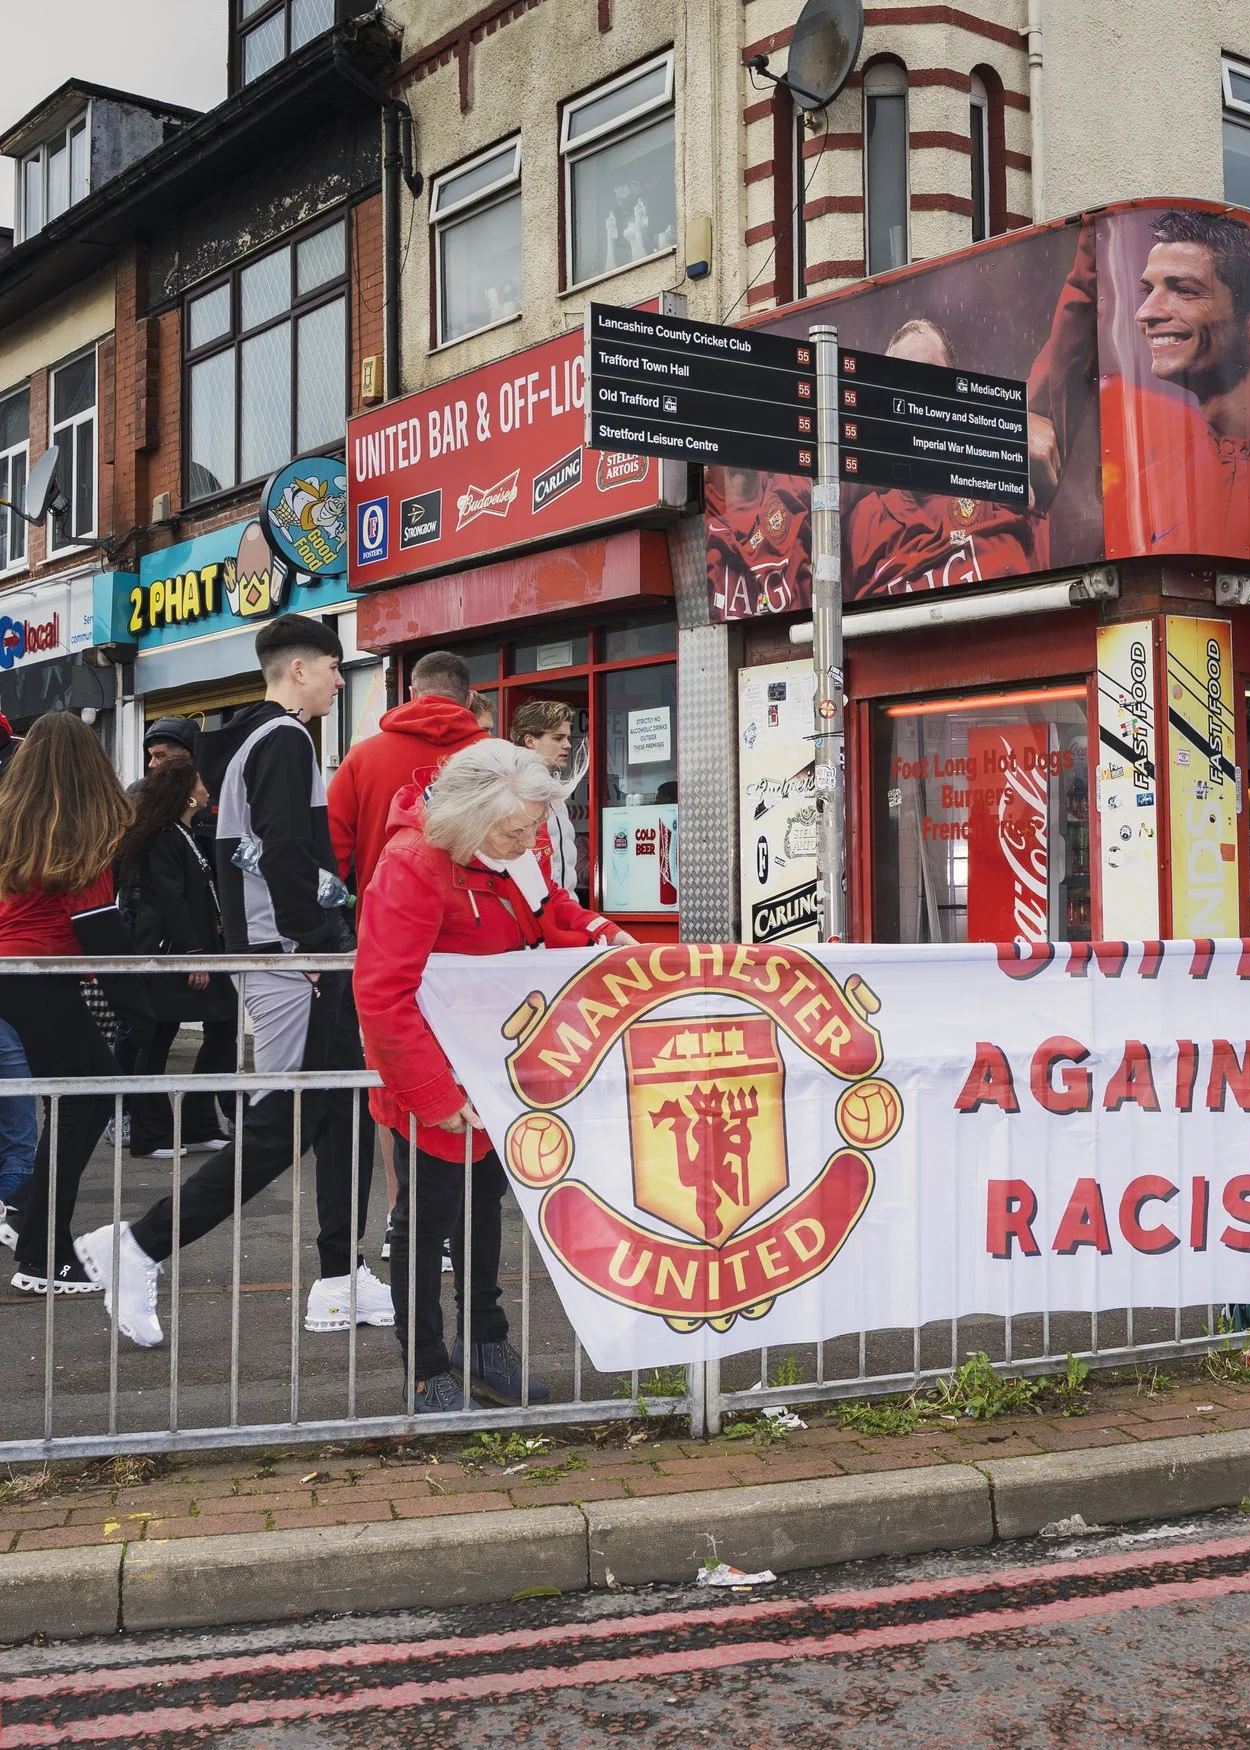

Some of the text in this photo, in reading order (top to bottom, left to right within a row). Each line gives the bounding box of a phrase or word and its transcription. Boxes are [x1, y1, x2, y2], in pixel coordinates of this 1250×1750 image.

[599, 315, 810, 362] Lancashire County Cricket Club 55
[599, 351, 810, 396] Trafford Town Hall 55
[844, 360, 1022, 401] 55 MediaCityUK
[355, 355, 585, 483] UNITED BAR & OFF-LIC
[599, 388, 811, 430] Old Trafford 55
[844, 393, 1023, 433] 55 The Lowry and Salford Quays
[599, 425, 811, 464] Stretford Leisure Centre 55
[845, 426, 1023, 463] 55 Imperial War Museum North
[534, 457, 580, 503] CARLING
[606, 460, 639, 480] ARTOIS
[845, 459, 1024, 494] 55 Manchester United
[457, 485, 518, 521] Budweiser
[404, 520, 437, 541] STRONGBOW
[129, 563, 220, 633] 2 PHAT
[1130, 641, 1150, 790] FAST FOOD
[1206, 638, 1224, 786] FAST FOOD
[893, 746, 1074, 782] Foot Long Hot Dogs
[941, 784, 1014, 810] Burgers
[635, 828, 656, 841] COLD
[793, 840, 817, 851] ARTO
[922, 817, 973, 841] Frenc
[635, 843, 656, 856] BEER
[538, 945, 853, 1079] MANCHESTER
[608, 1218, 826, 1301] UNITED
